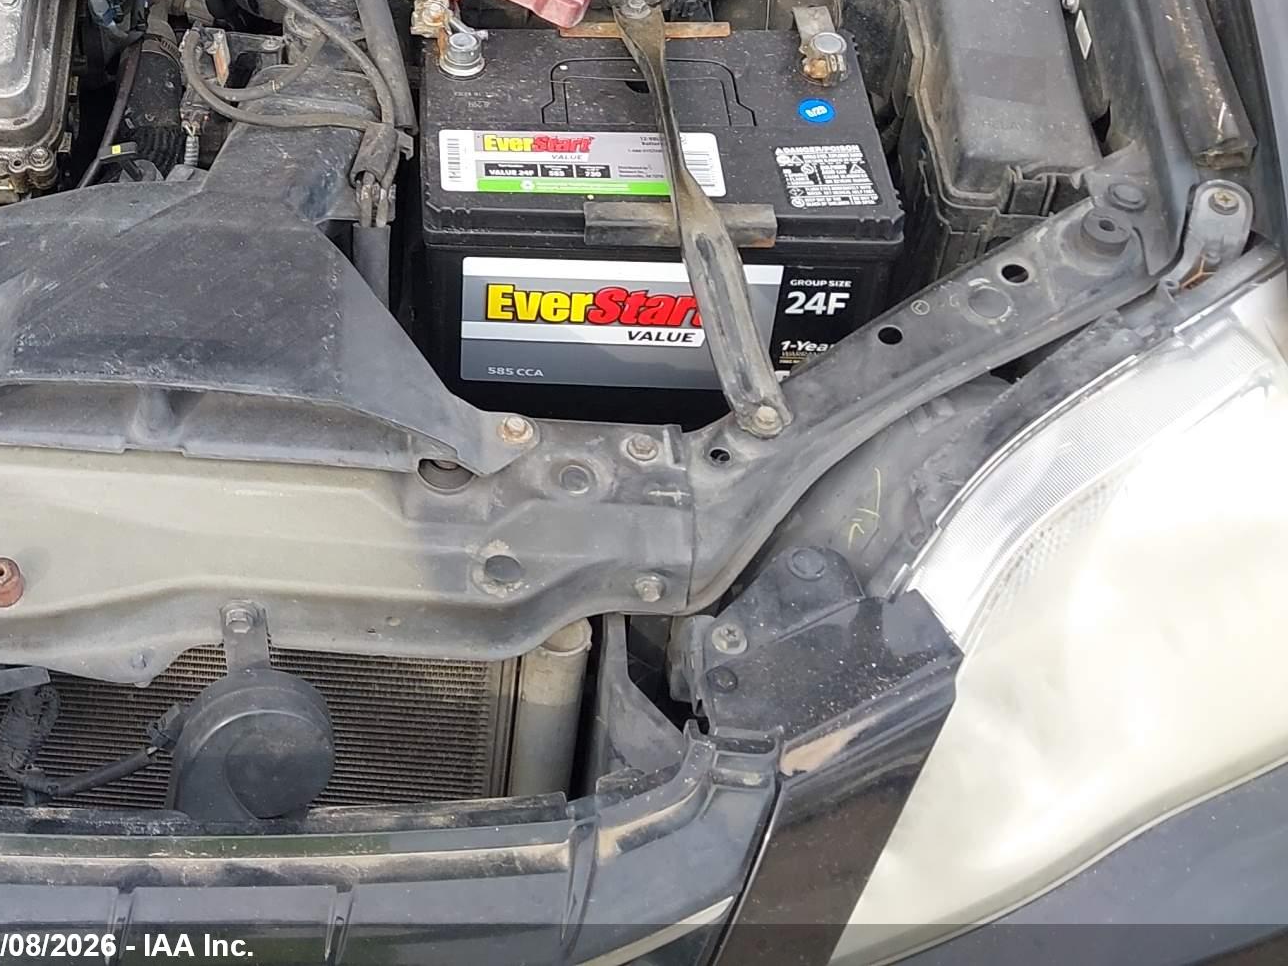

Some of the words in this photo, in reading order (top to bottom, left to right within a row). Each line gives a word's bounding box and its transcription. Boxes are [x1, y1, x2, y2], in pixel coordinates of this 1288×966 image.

[483, 134, 591, 153] EverStart
[790, 279, 827, 287] GROUP
[784, 291, 850, 315] 24F
[627, 330, 696, 343] VALUE
[488, 366, 513, 376] 585
[516, 368, 544, 377] CCA
